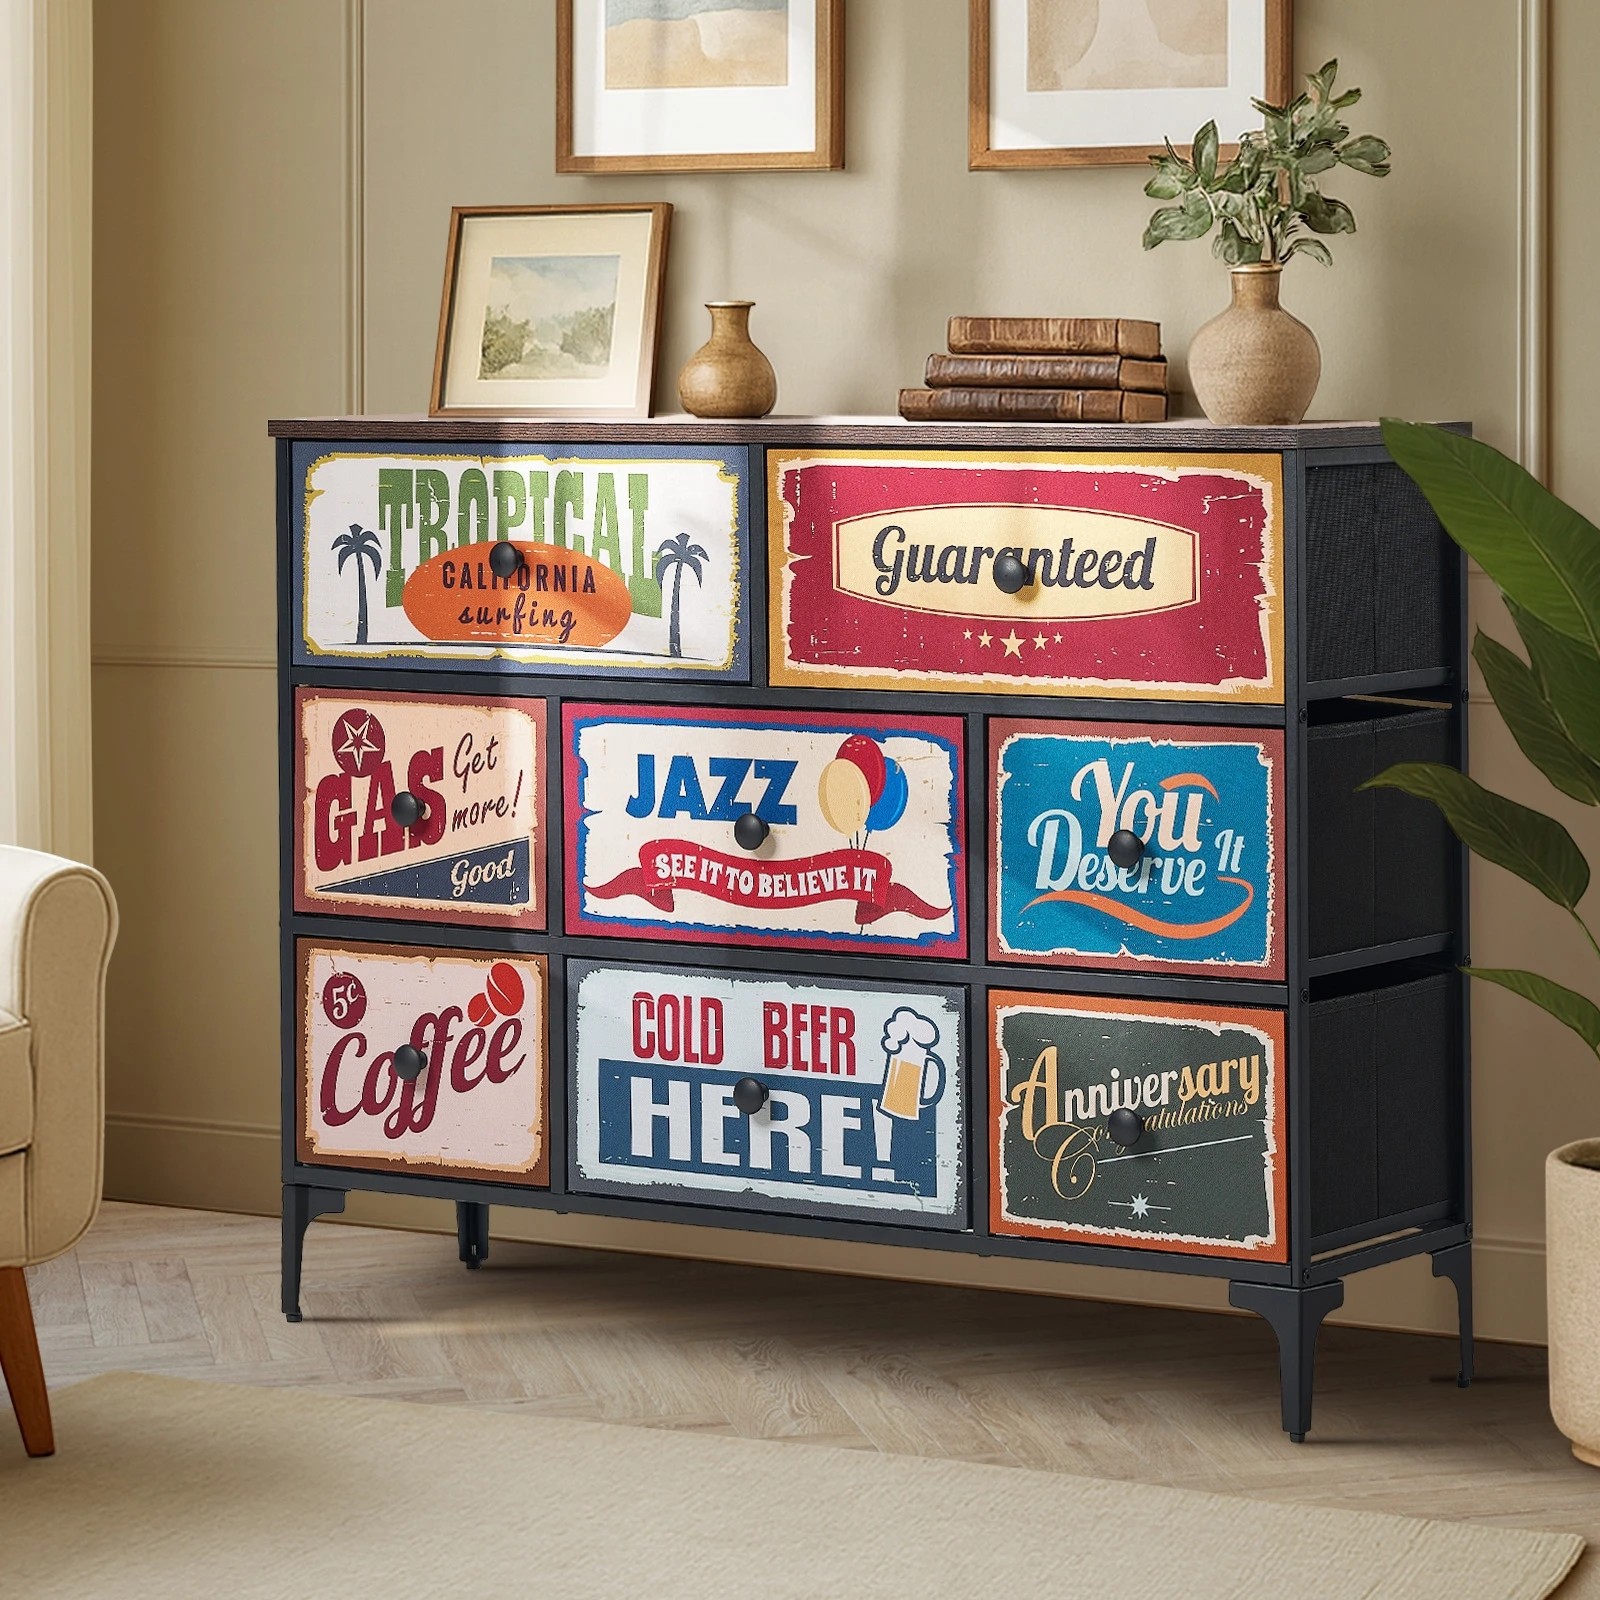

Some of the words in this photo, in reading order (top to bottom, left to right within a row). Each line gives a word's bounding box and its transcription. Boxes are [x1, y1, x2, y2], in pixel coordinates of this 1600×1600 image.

[378, 468, 662, 618] TROPICAL
[458, 593, 577, 643] surfing
[452, 770, 523, 832] more!
[454, 733, 499, 793] Get
[626, 754, 798, 825] JAZZ
[1070, 758, 1203, 852] You
[315, 746, 446, 872] GAS
[1027, 809, 1206, 896] Deserve
[1214, 829, 1245, 873] It
[451, 850, 516, 897] Good
[655, 854, 697, 879] SEE
[699, 858, 722, 885] IT
[725, 866, 754, 895] TO
[757, 866, 849, 898] BELIEVE
[853, 867, 877, 892] IT
[320, 1005, 526, 1139] Coffee
[632, 991, 723, 1065] COLD
[763, 1001, 856, 1076] BEER
[630, 1077, 895, 1181] HERE!
[1011, 1046, 1259, 1141] Anniversary
[1033, 1098, 1248, 1200] Coatulations
